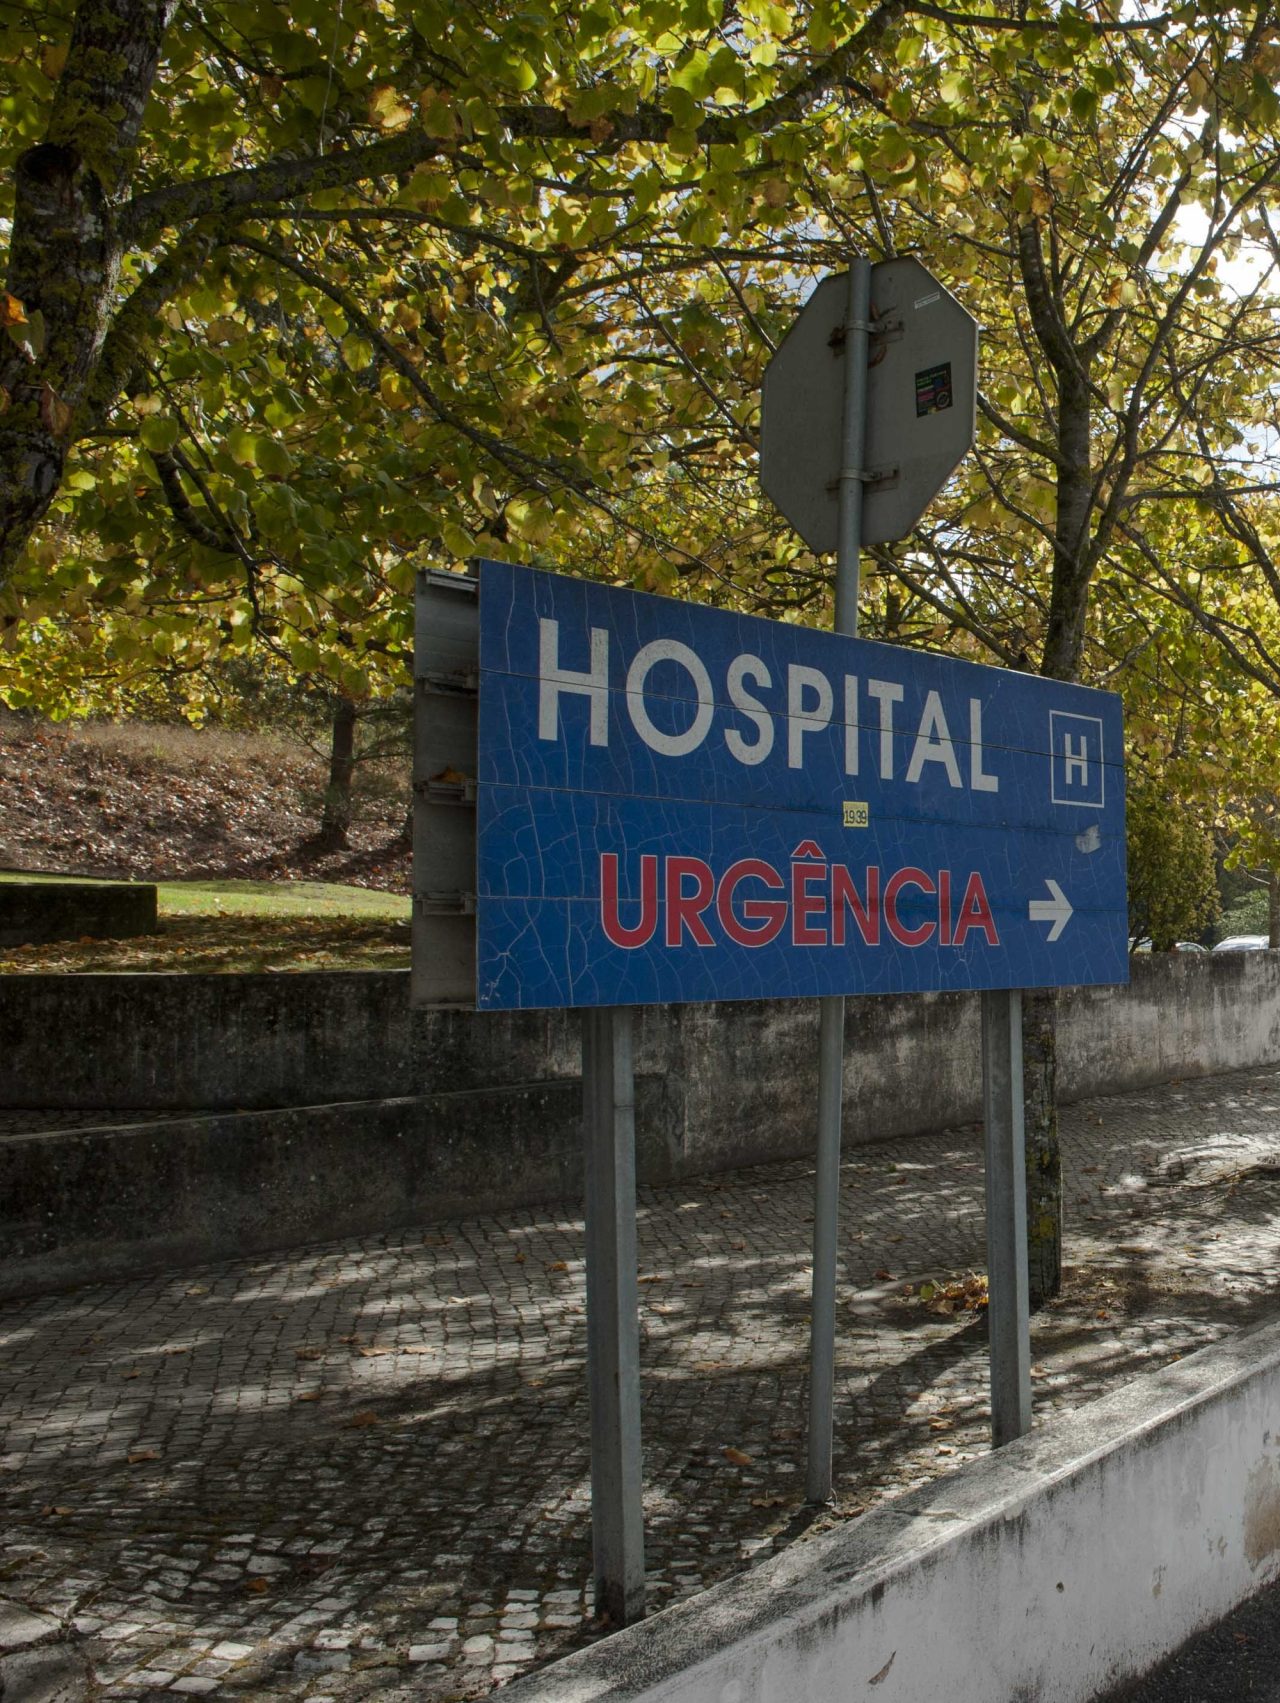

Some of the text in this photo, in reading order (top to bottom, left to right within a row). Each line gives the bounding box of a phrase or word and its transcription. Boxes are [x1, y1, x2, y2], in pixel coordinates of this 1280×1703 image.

[538, 618, 999, 792] HOSPITAL
[1064, 733, 1088, 786] H
[600, 840, 1000, 949] URGÊNCIA
